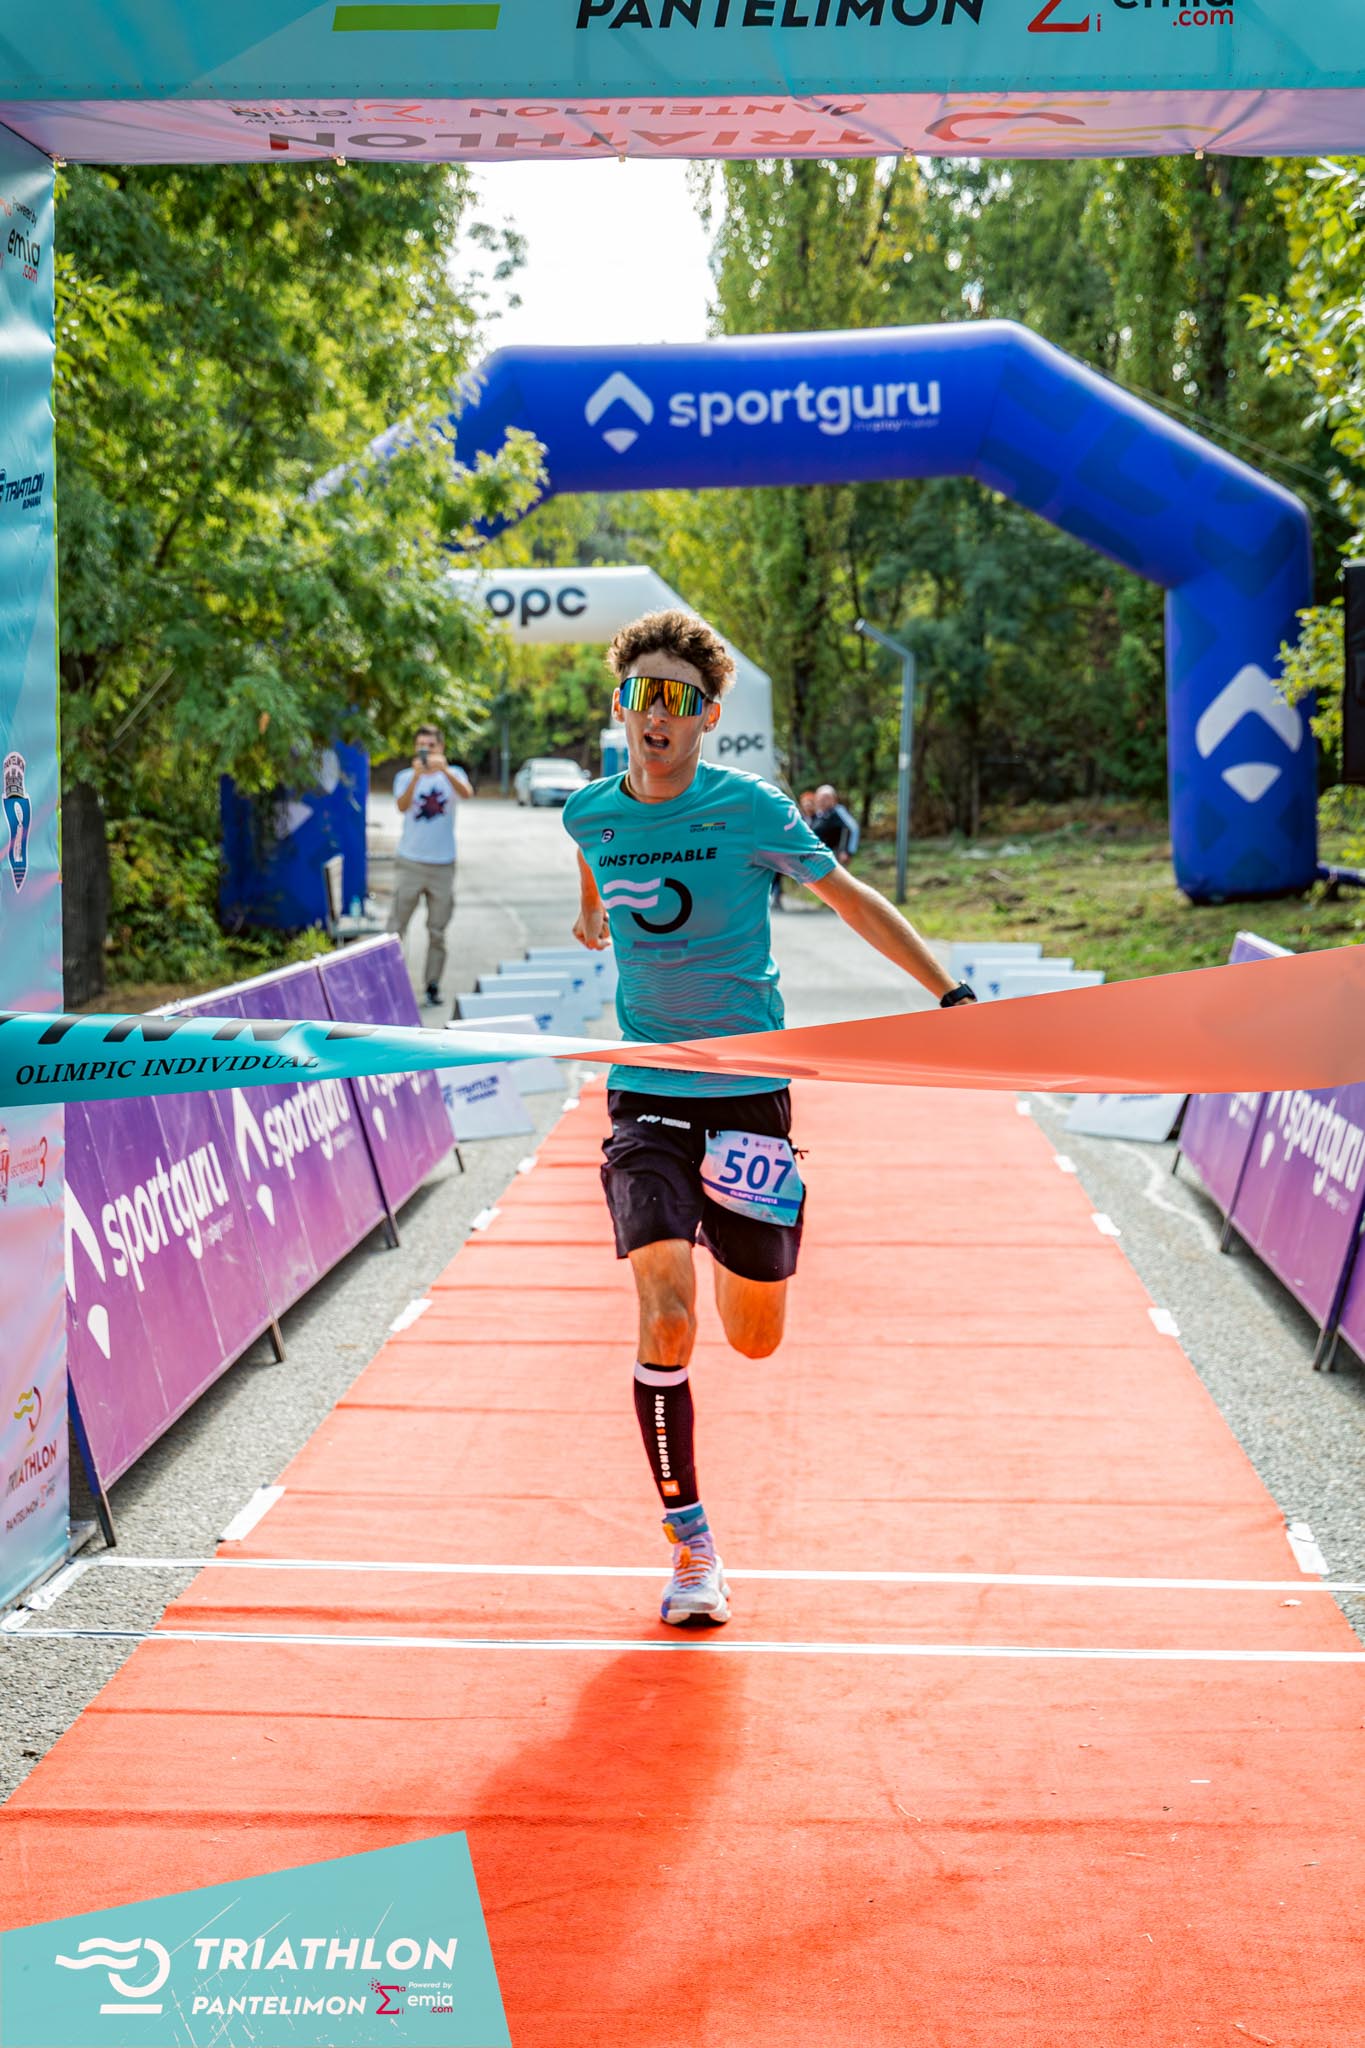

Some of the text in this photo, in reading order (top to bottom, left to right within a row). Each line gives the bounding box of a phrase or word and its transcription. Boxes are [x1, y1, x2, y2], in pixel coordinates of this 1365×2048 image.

[1172, 9, 1234, 27] .com
[269, 128, 876, 151] TRIATHLON
[7, 228, 41, 268] emia
[668, 380, 941, 437] sportguru
[598, 847, 717, 867] UNSTOPPABLE
[16, 1055, 320, 1085] OLIMPIC INDIVIDUAL
[718, 1149, 793, 1193] 507
[101, 1141, 230, 1292] sportguru
